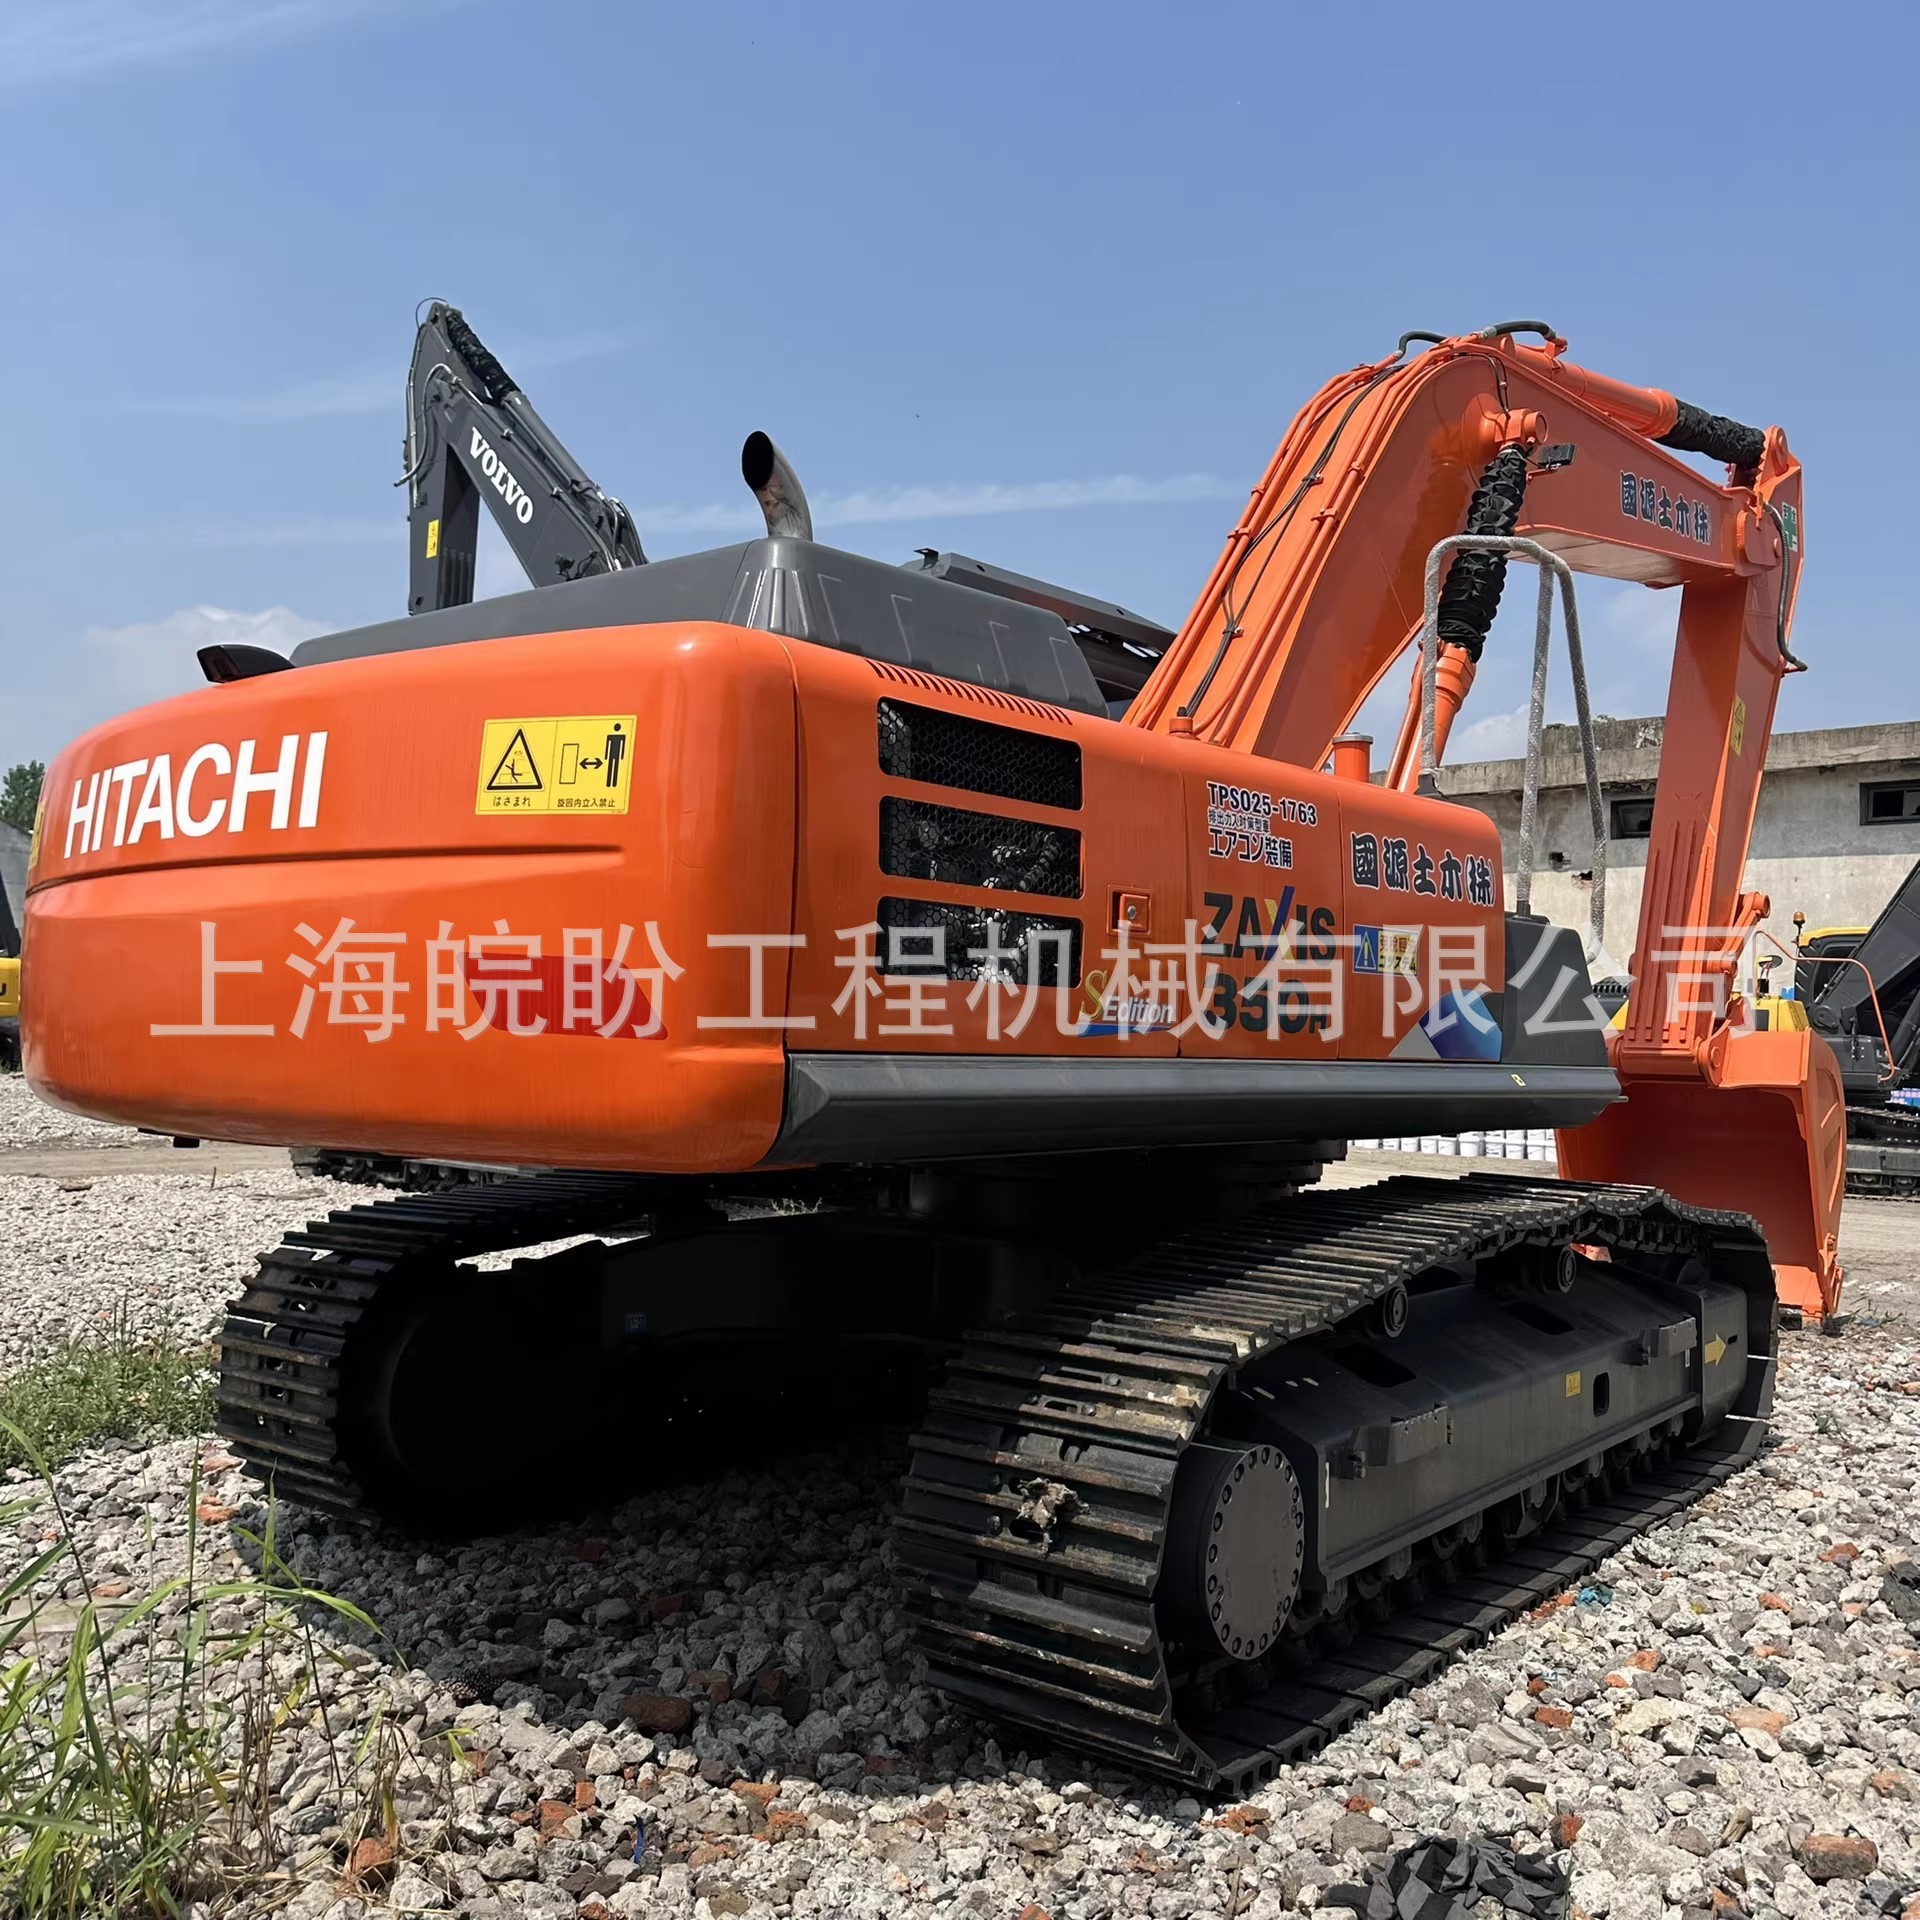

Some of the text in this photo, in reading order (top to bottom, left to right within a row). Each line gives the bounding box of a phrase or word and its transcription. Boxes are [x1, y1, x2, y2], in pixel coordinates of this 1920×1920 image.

[469, 427, 534, 524] VOLVO
[63, 731, 329, 859] HITACHI
[492, 796, 531, 807] はさまれ
[557, 798, 616, 808] 旋回内立入禁止
[1206, 780, 1319, 827] TPS025-1763
[1208, 827, 1293, 869] エアコン装備
[1200, 885, 1337, 966] ZAXIS
